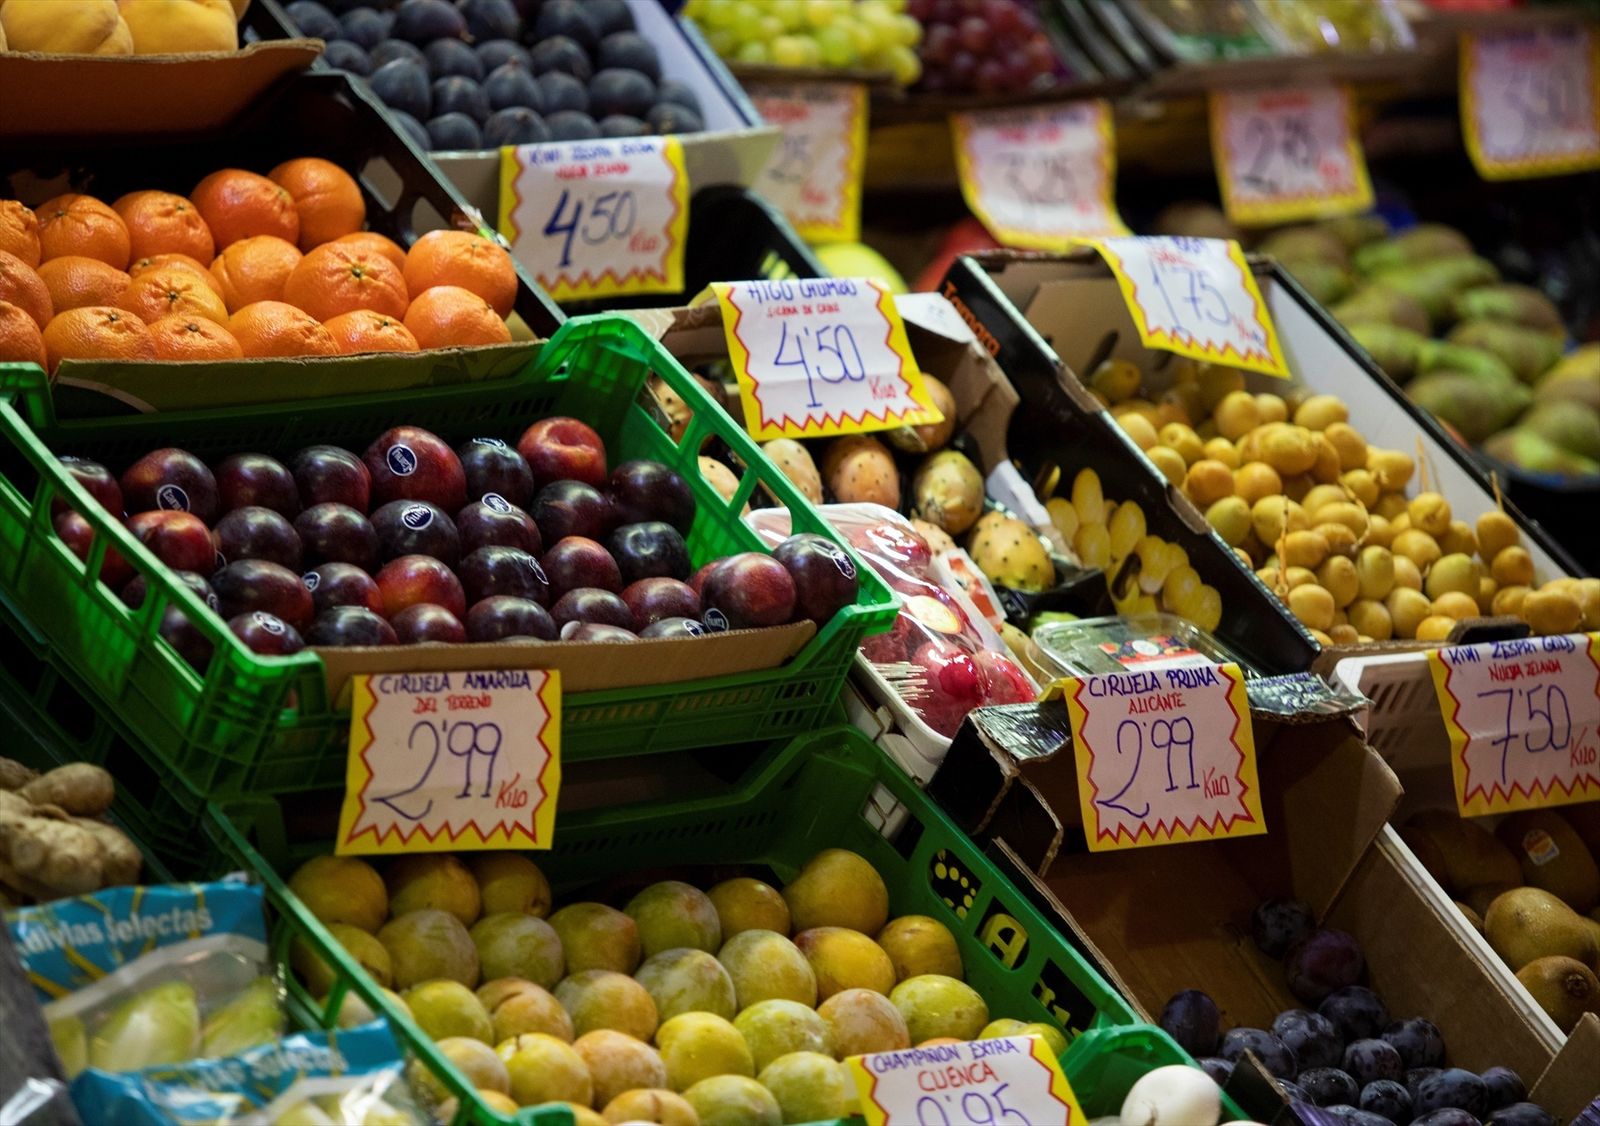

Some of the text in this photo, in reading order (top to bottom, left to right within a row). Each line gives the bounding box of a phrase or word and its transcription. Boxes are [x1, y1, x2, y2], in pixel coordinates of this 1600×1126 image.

[773, 320, 866, 408] 4'50
[379, 669, 532, 694] CIRUELA AMARILLA
[1088, 665, 1221, 697] CIRUELA PRUNA
[1128, 693, 1187, 715] ALICANTE
[1477, 684, 1571, 785] 7'50
[370, 719, 502, 821] 2'99
[1096, 716, 1200, 819] 2'99
[968, 1038, 1020, 1060] EXTRA
[917, 1059, 1000, 1092] CUENCA
